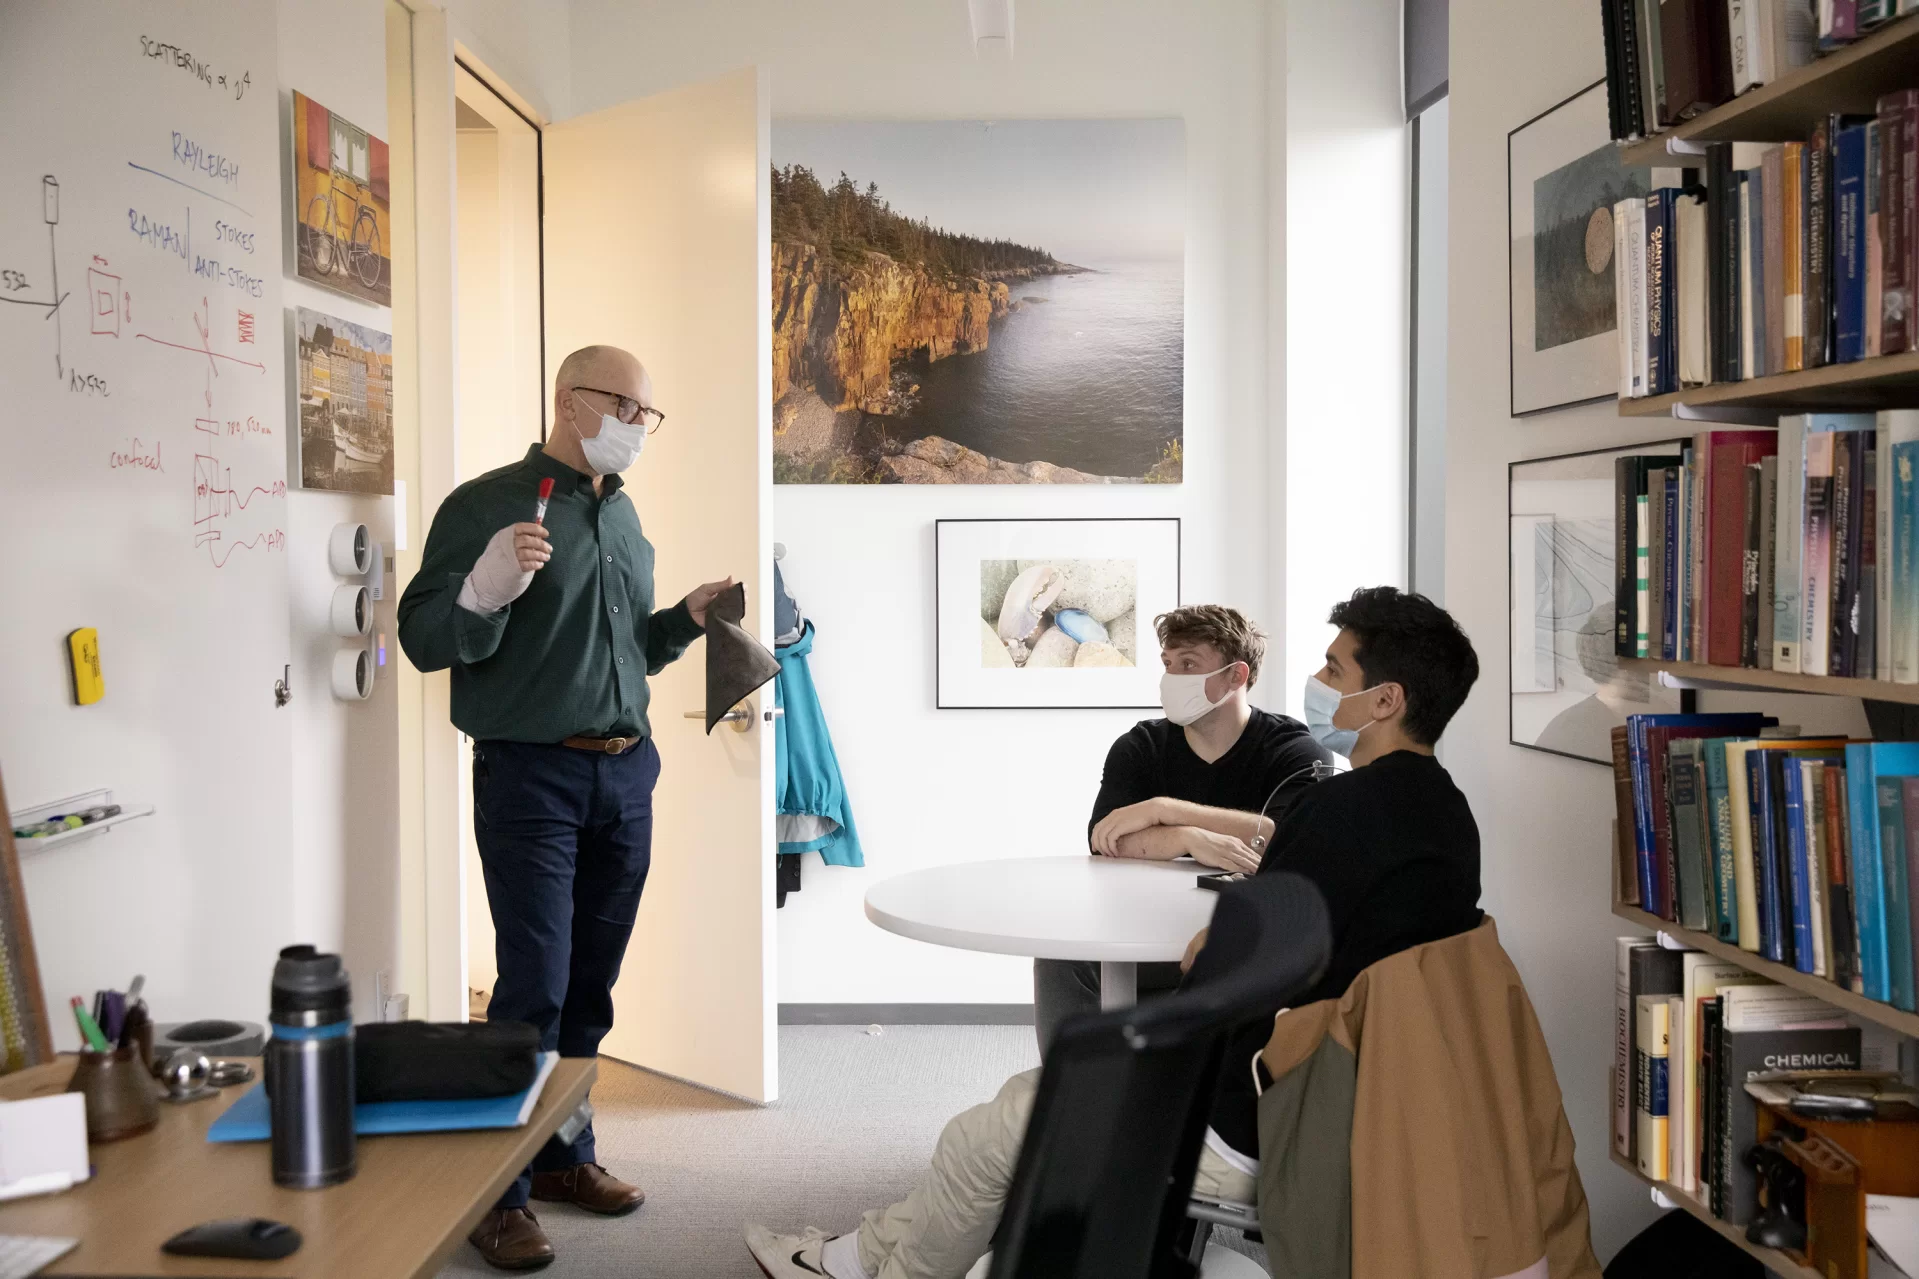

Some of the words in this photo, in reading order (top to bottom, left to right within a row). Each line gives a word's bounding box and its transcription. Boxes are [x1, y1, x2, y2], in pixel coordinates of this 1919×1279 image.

[140, 35, 212, 89] SCATTERING
[171, 129, 239, 190] RAYLEIGH
[128, 207, 187, 260] RAMAN
[214, 219, 255, 255] STOKES
[1654, 225, 1664, 284] QUANTUM
[1810, 205, 1820, 275] CHEMISTRY
[1, 269, 32, 292] 532
[194, 254, 264, 299] ANTI-STOKES
[1630, 231, 1640, 292] QUANTUM
[1653, 285, 1663, 337] PHYSICS
[109, 437, 165, 474] confocal
[1665, 541, 1674, 592] CHEMISTRY
[1805, 576, 1816, 642] CHEMISTRY
[1719, 854, 1729, 917] GEOMETRY
[1726, 853, 1734, 880] AND
[1616, 1007, 1627, 1113] BIOCHEMISTRY
[1763, 1053, 1856, 1067] CHEMICAL
